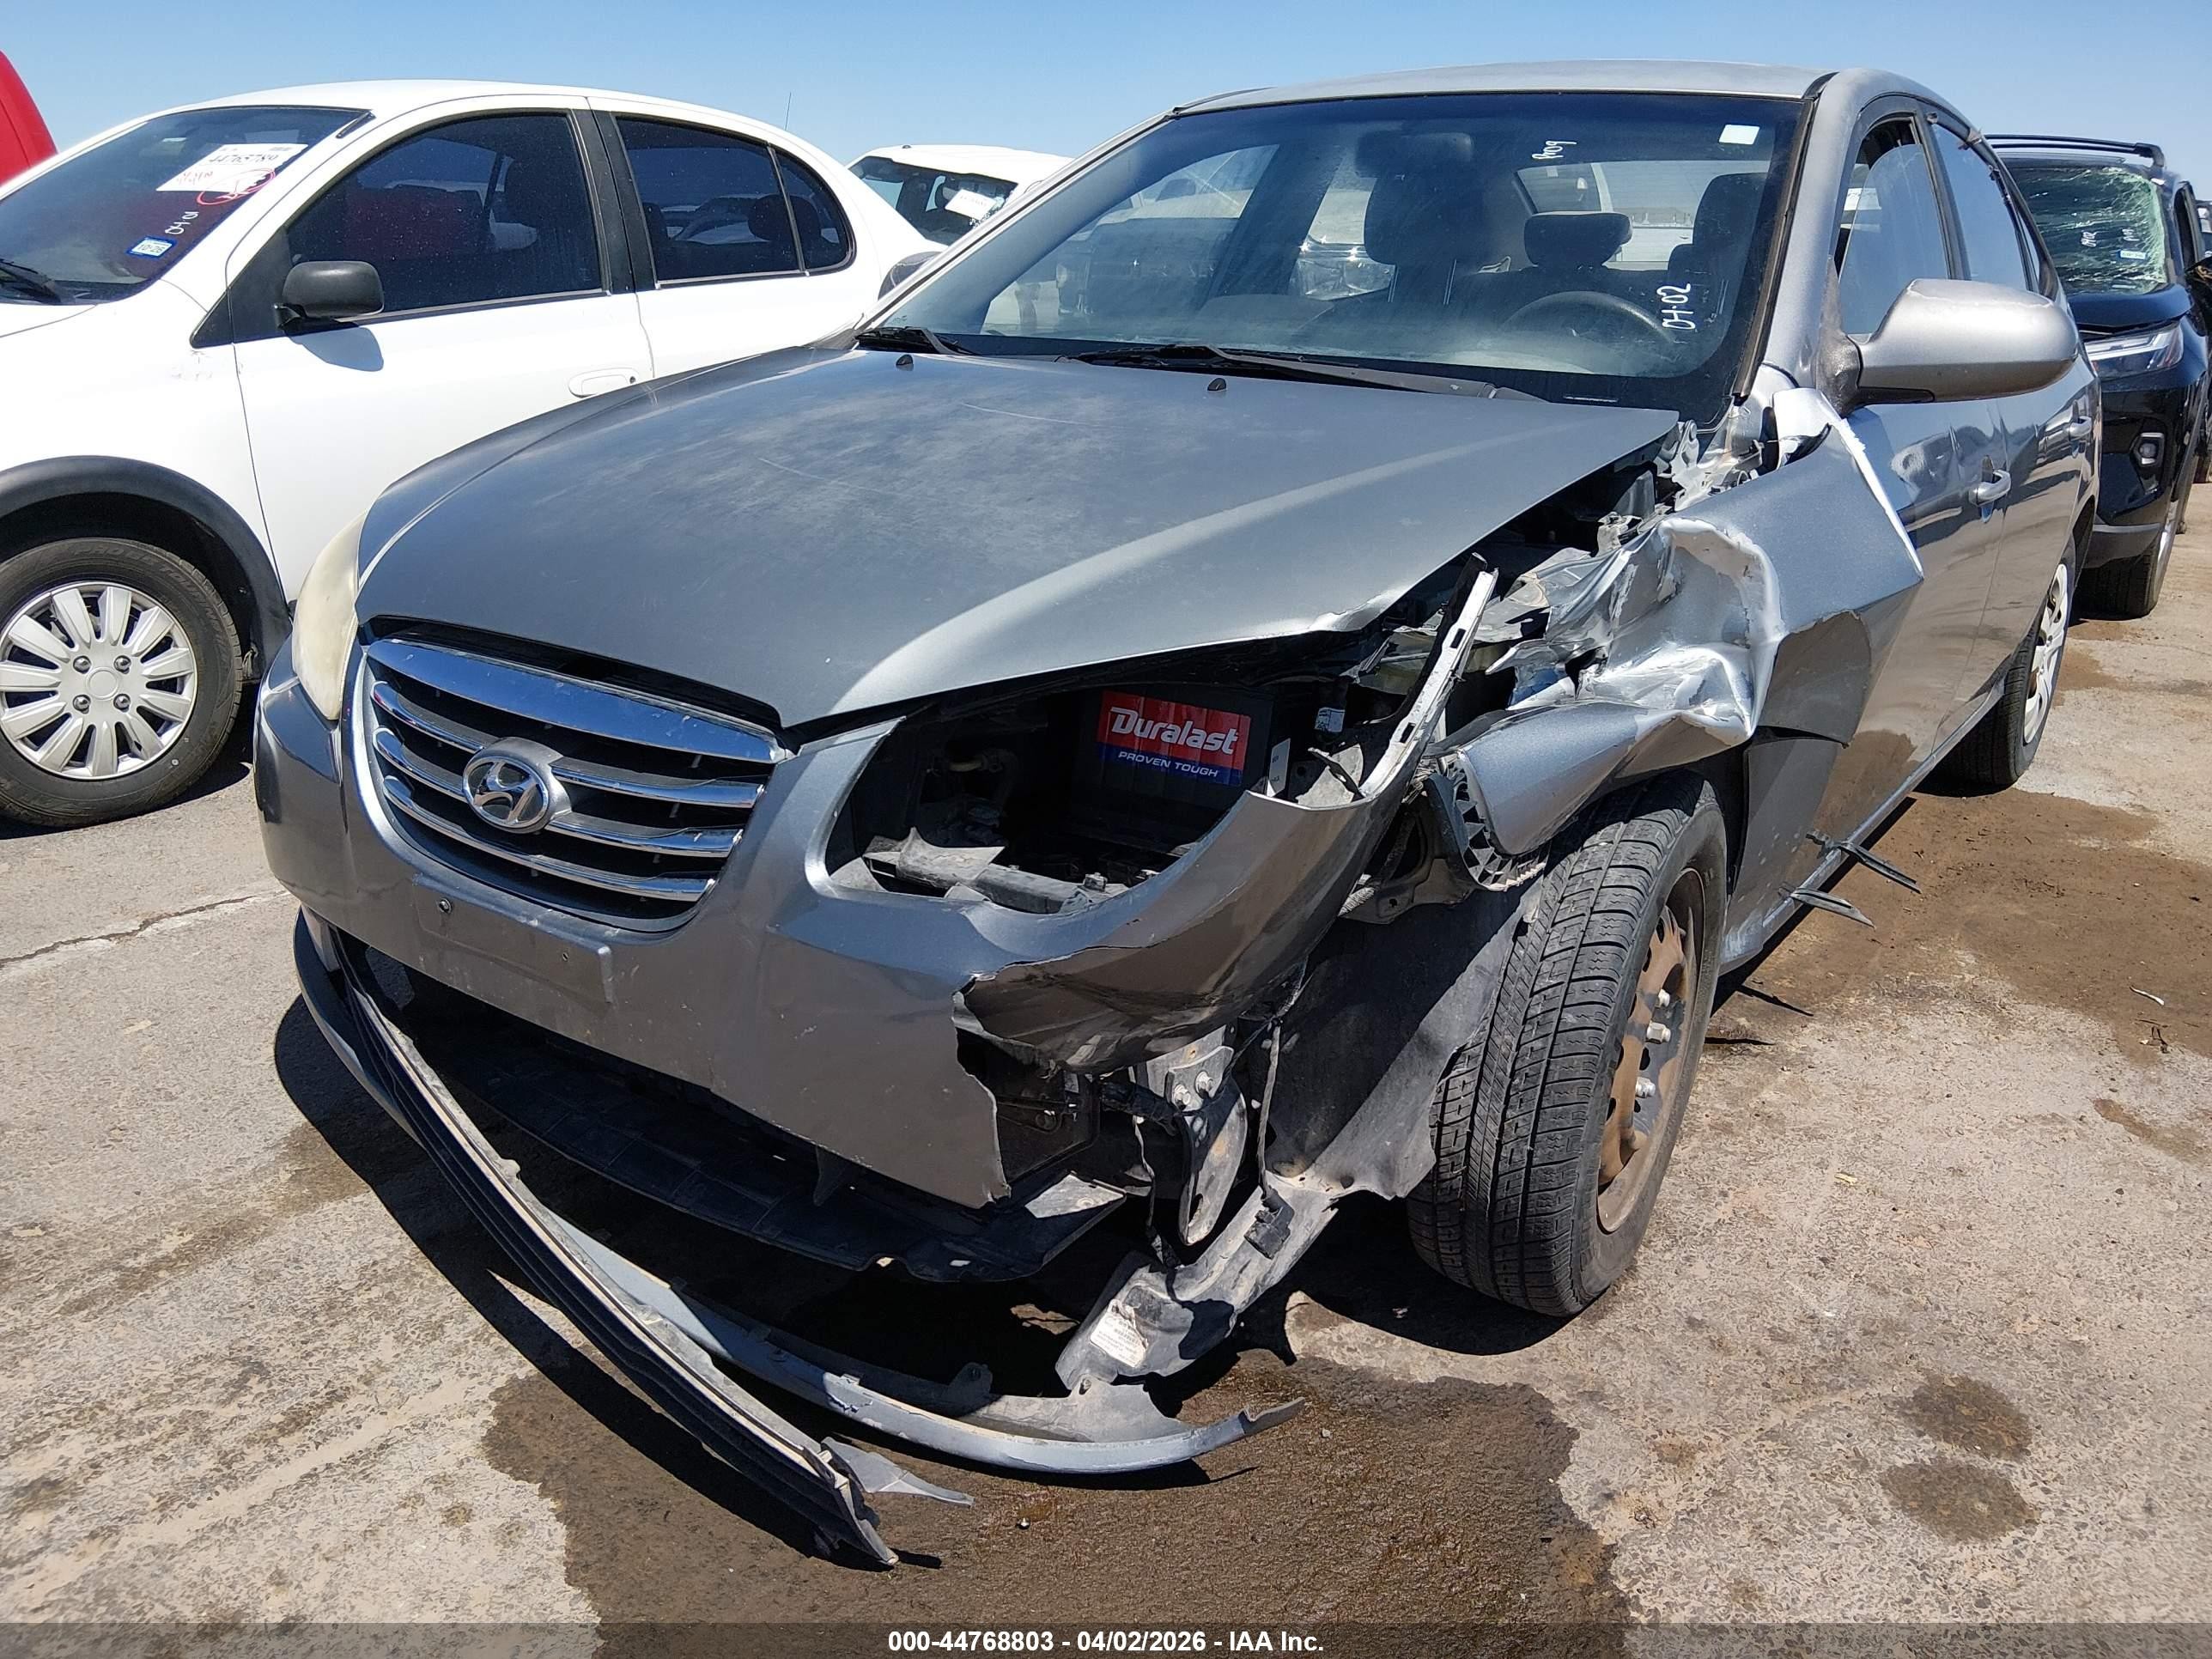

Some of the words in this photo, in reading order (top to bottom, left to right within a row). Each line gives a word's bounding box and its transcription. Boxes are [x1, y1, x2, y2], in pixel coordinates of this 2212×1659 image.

[1109, 706, 1240, 756] Duralast
[1117, 750, 1172, 769] PROVEN
[1175, 762, 1219, 778] TOUGH
